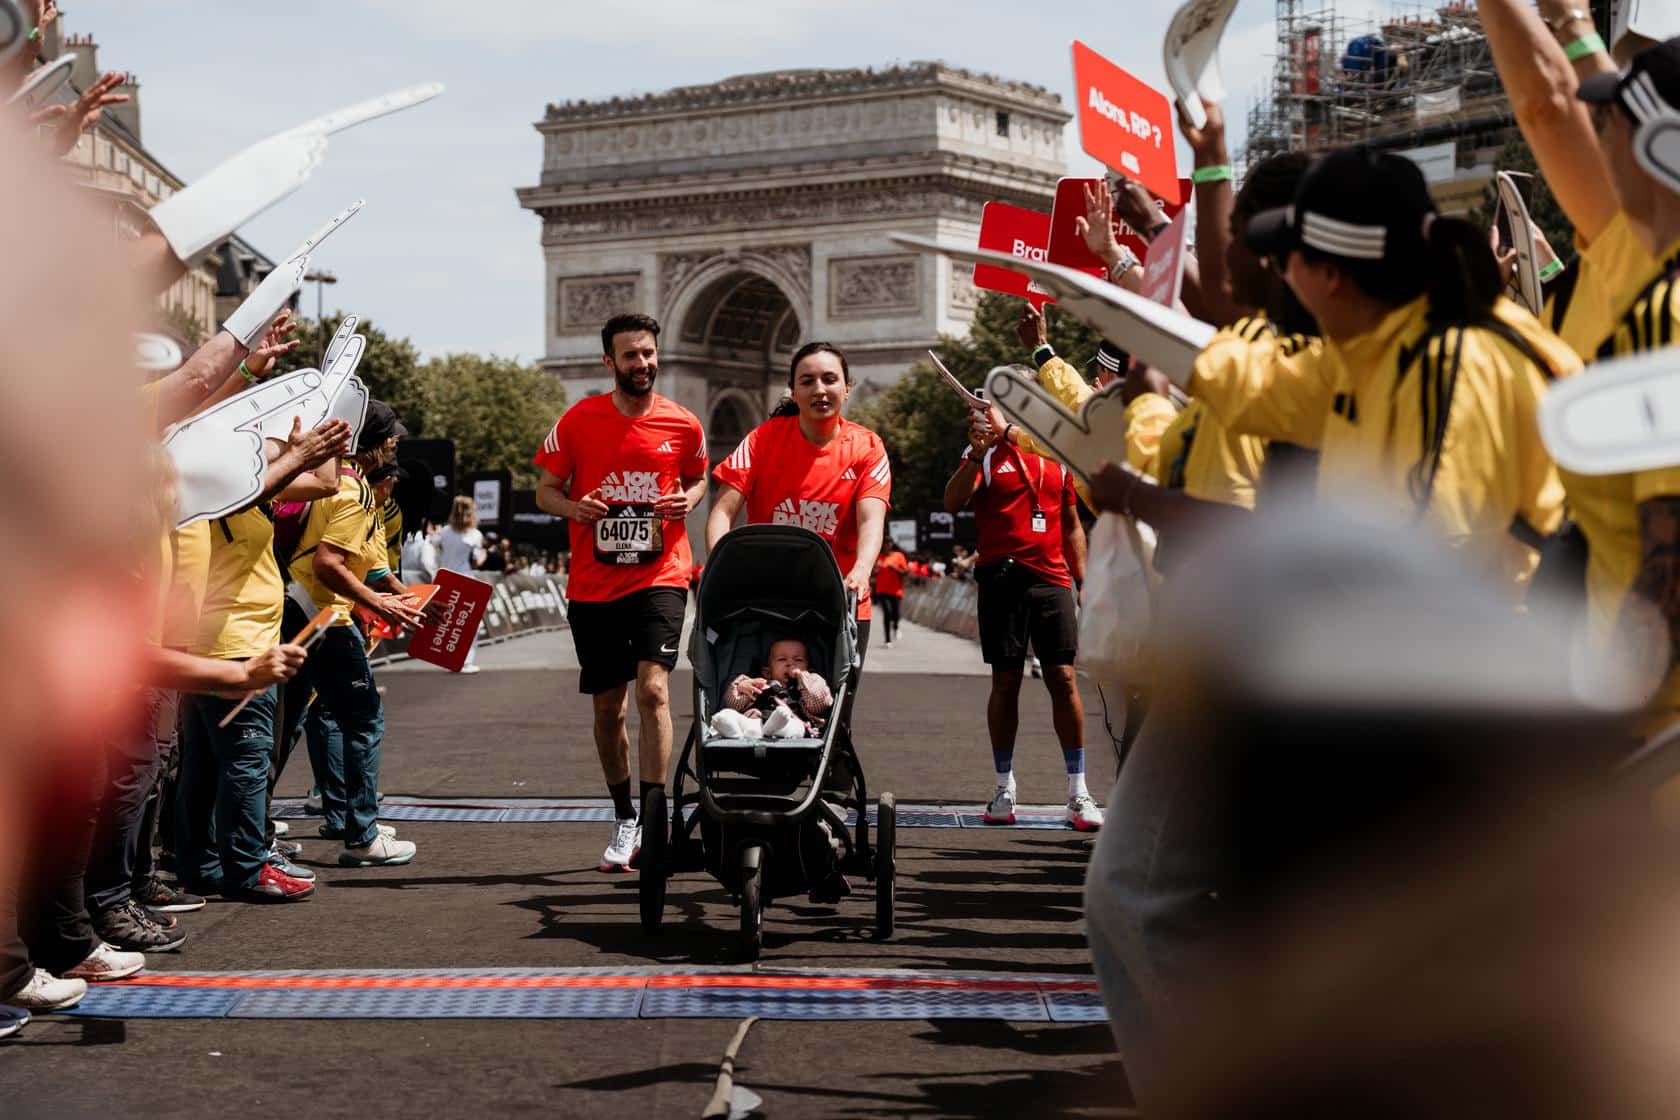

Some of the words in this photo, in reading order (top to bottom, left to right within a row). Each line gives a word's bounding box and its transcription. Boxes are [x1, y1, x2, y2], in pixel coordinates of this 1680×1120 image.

[1089, 86, 1131, 133] Alors,
[1129, 111, 1152, 140] RP
[1151, 124, 1162, 149] ?
[1012, 238, 1049, 263] Bra
[622, 471, 660, 488] 10K
[601, 485, 662, 503] PARIS
[799, 499, 839, 520] 10K
[600, 520, 649, 541] 64075
[772, 511, 838, 535] PARIS
[432, 590, 461, 646] machine
[455, 601, 476, 626] T'es
[446, 628, 462, 652] une
